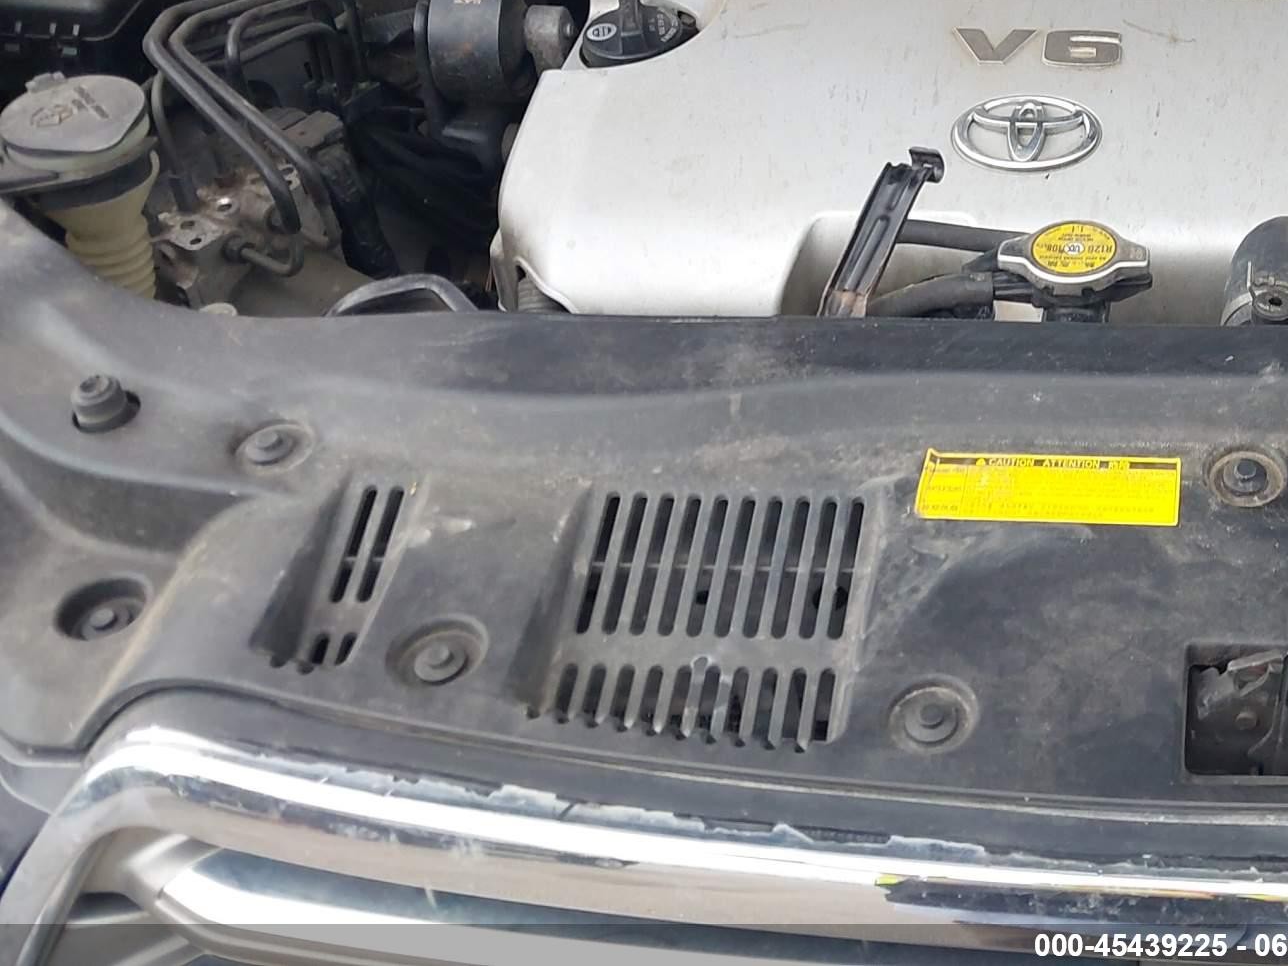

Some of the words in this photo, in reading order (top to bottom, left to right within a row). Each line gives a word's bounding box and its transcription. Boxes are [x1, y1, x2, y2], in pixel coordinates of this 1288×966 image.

[953, 27, 1122, 66] V6
[988, 458, 1035, 468] CAUTION
[1043, 458, 1101, 469] ATTENTION
